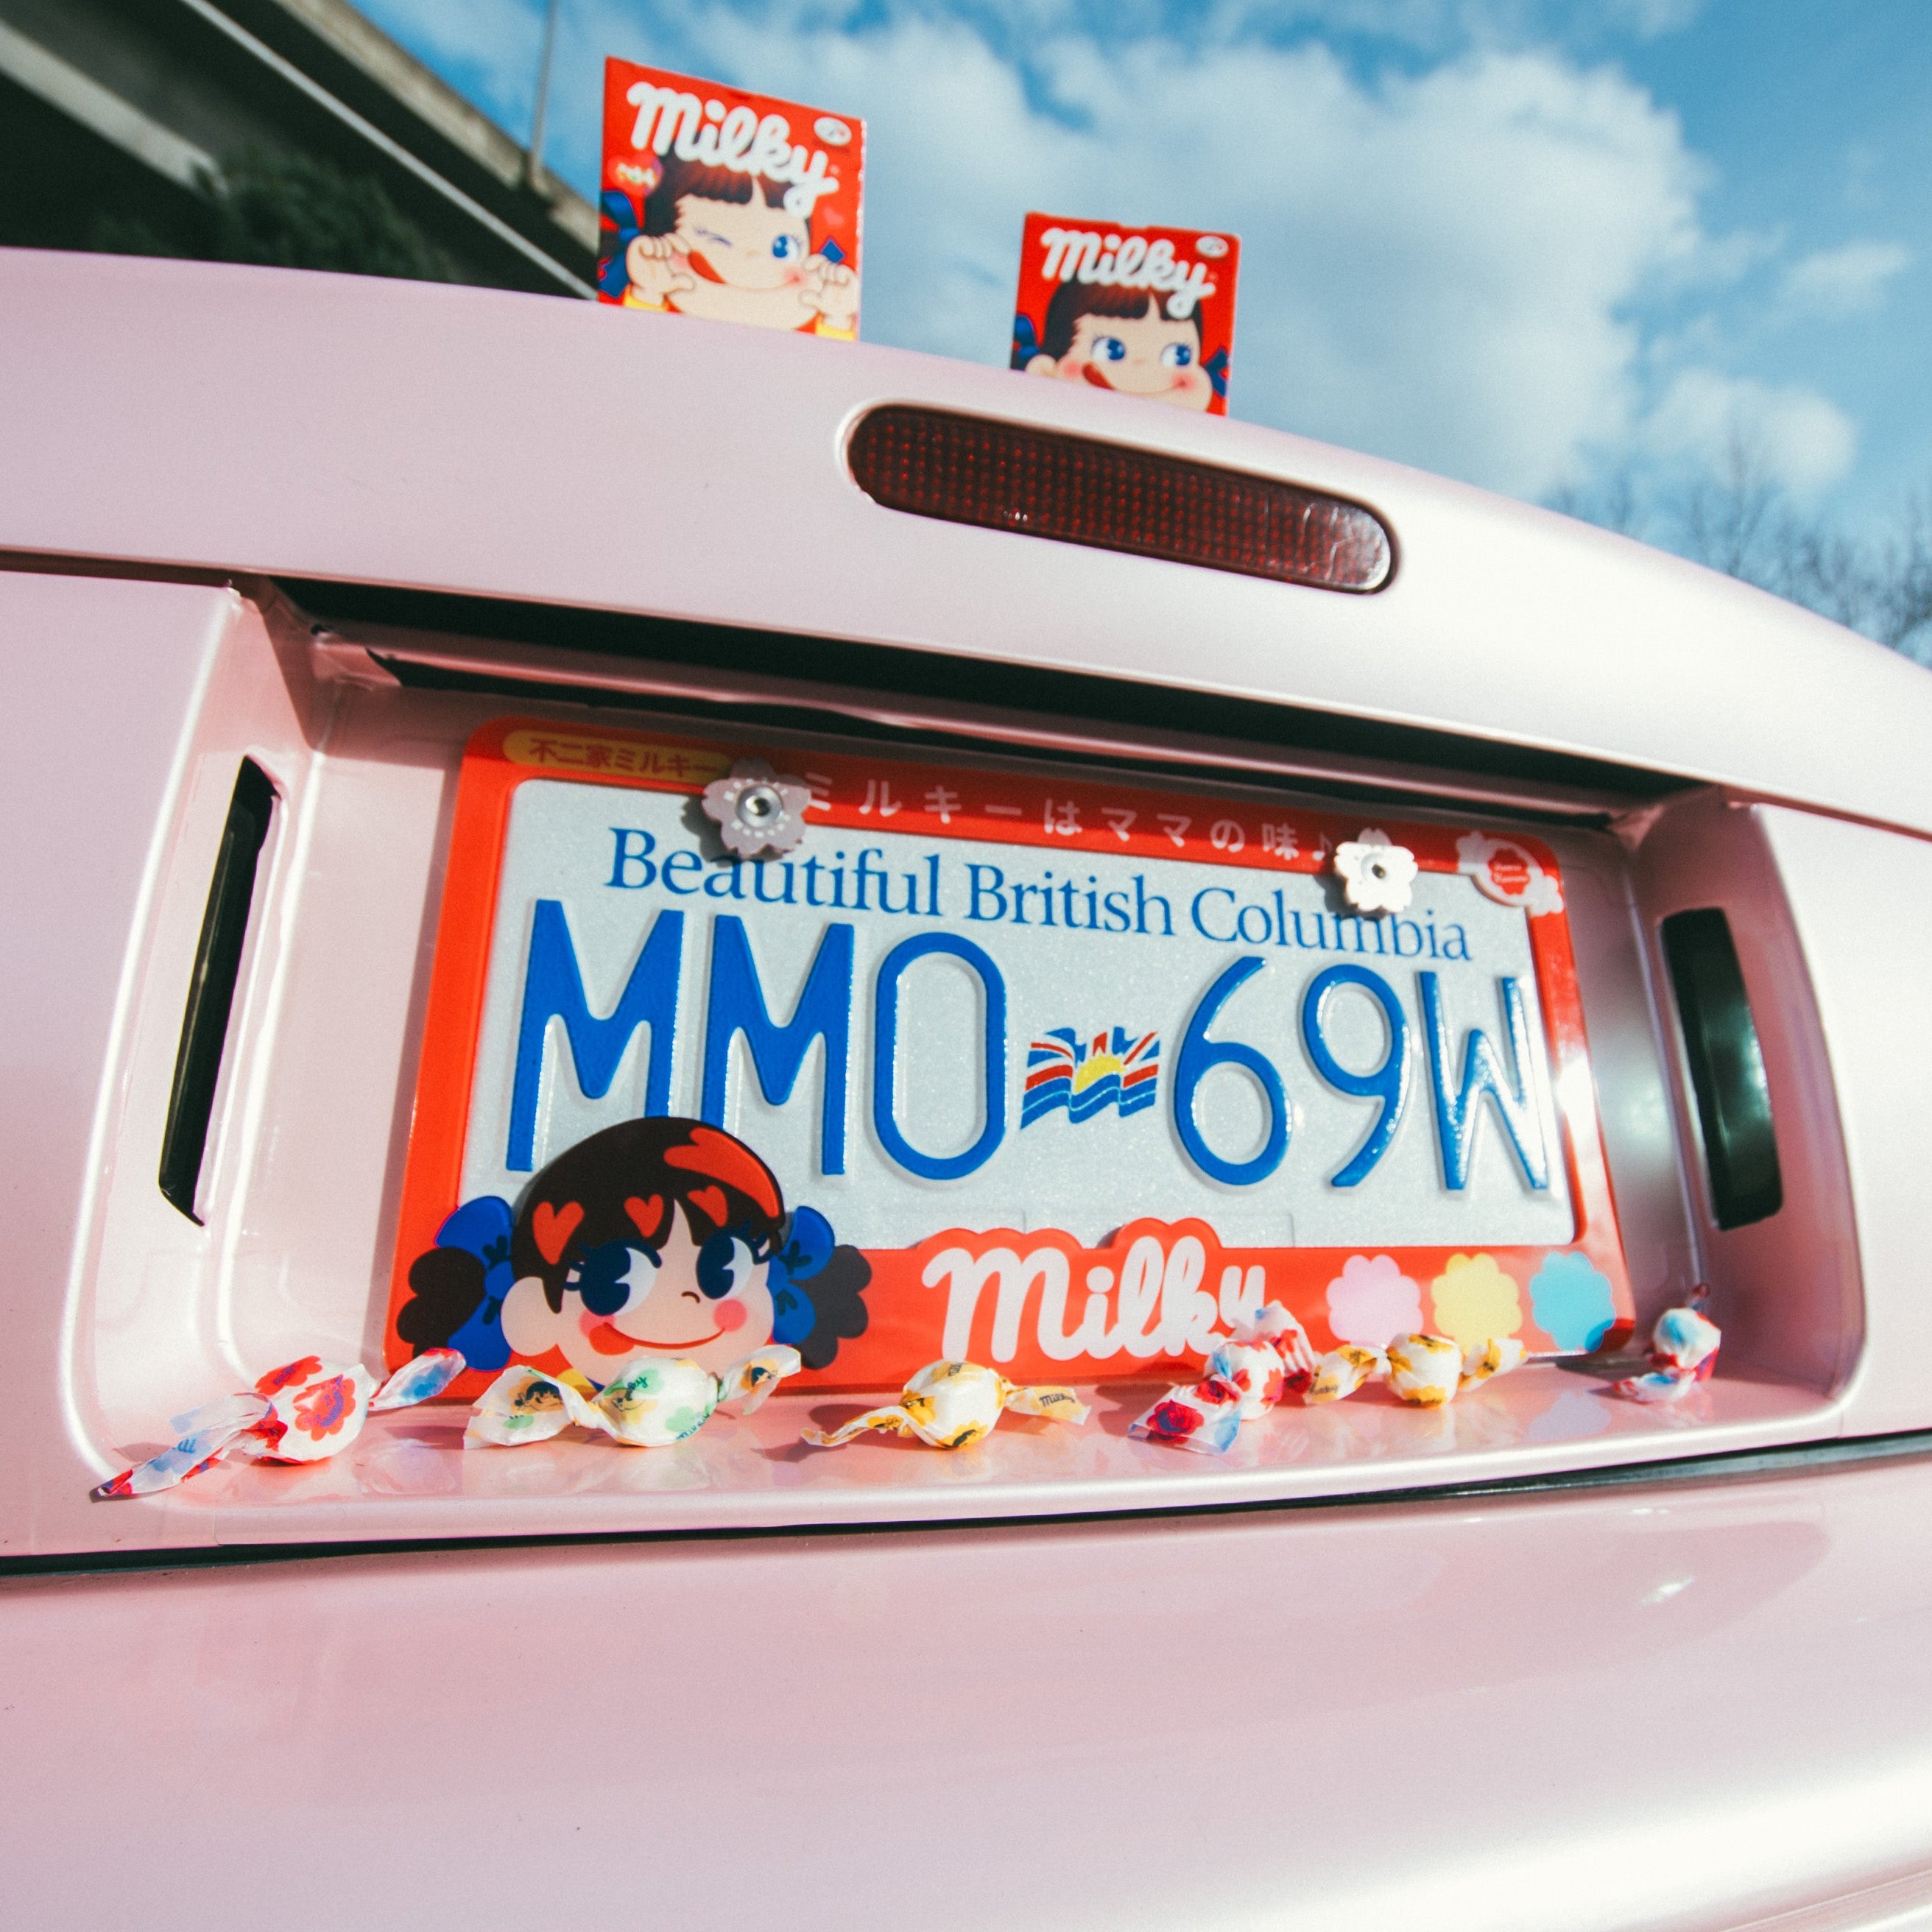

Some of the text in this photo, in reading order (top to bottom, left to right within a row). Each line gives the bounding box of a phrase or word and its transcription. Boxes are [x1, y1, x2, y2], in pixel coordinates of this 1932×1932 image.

[627, 82, 839, 219] Milky
[1041, 228, 1216, 320] Milky
[529, 737, 719, 778] 不二家ミルキー
[602, 826, 1473, 960] Beautiful British Columbia
[1175, 955, 1549, 1191] 69W
